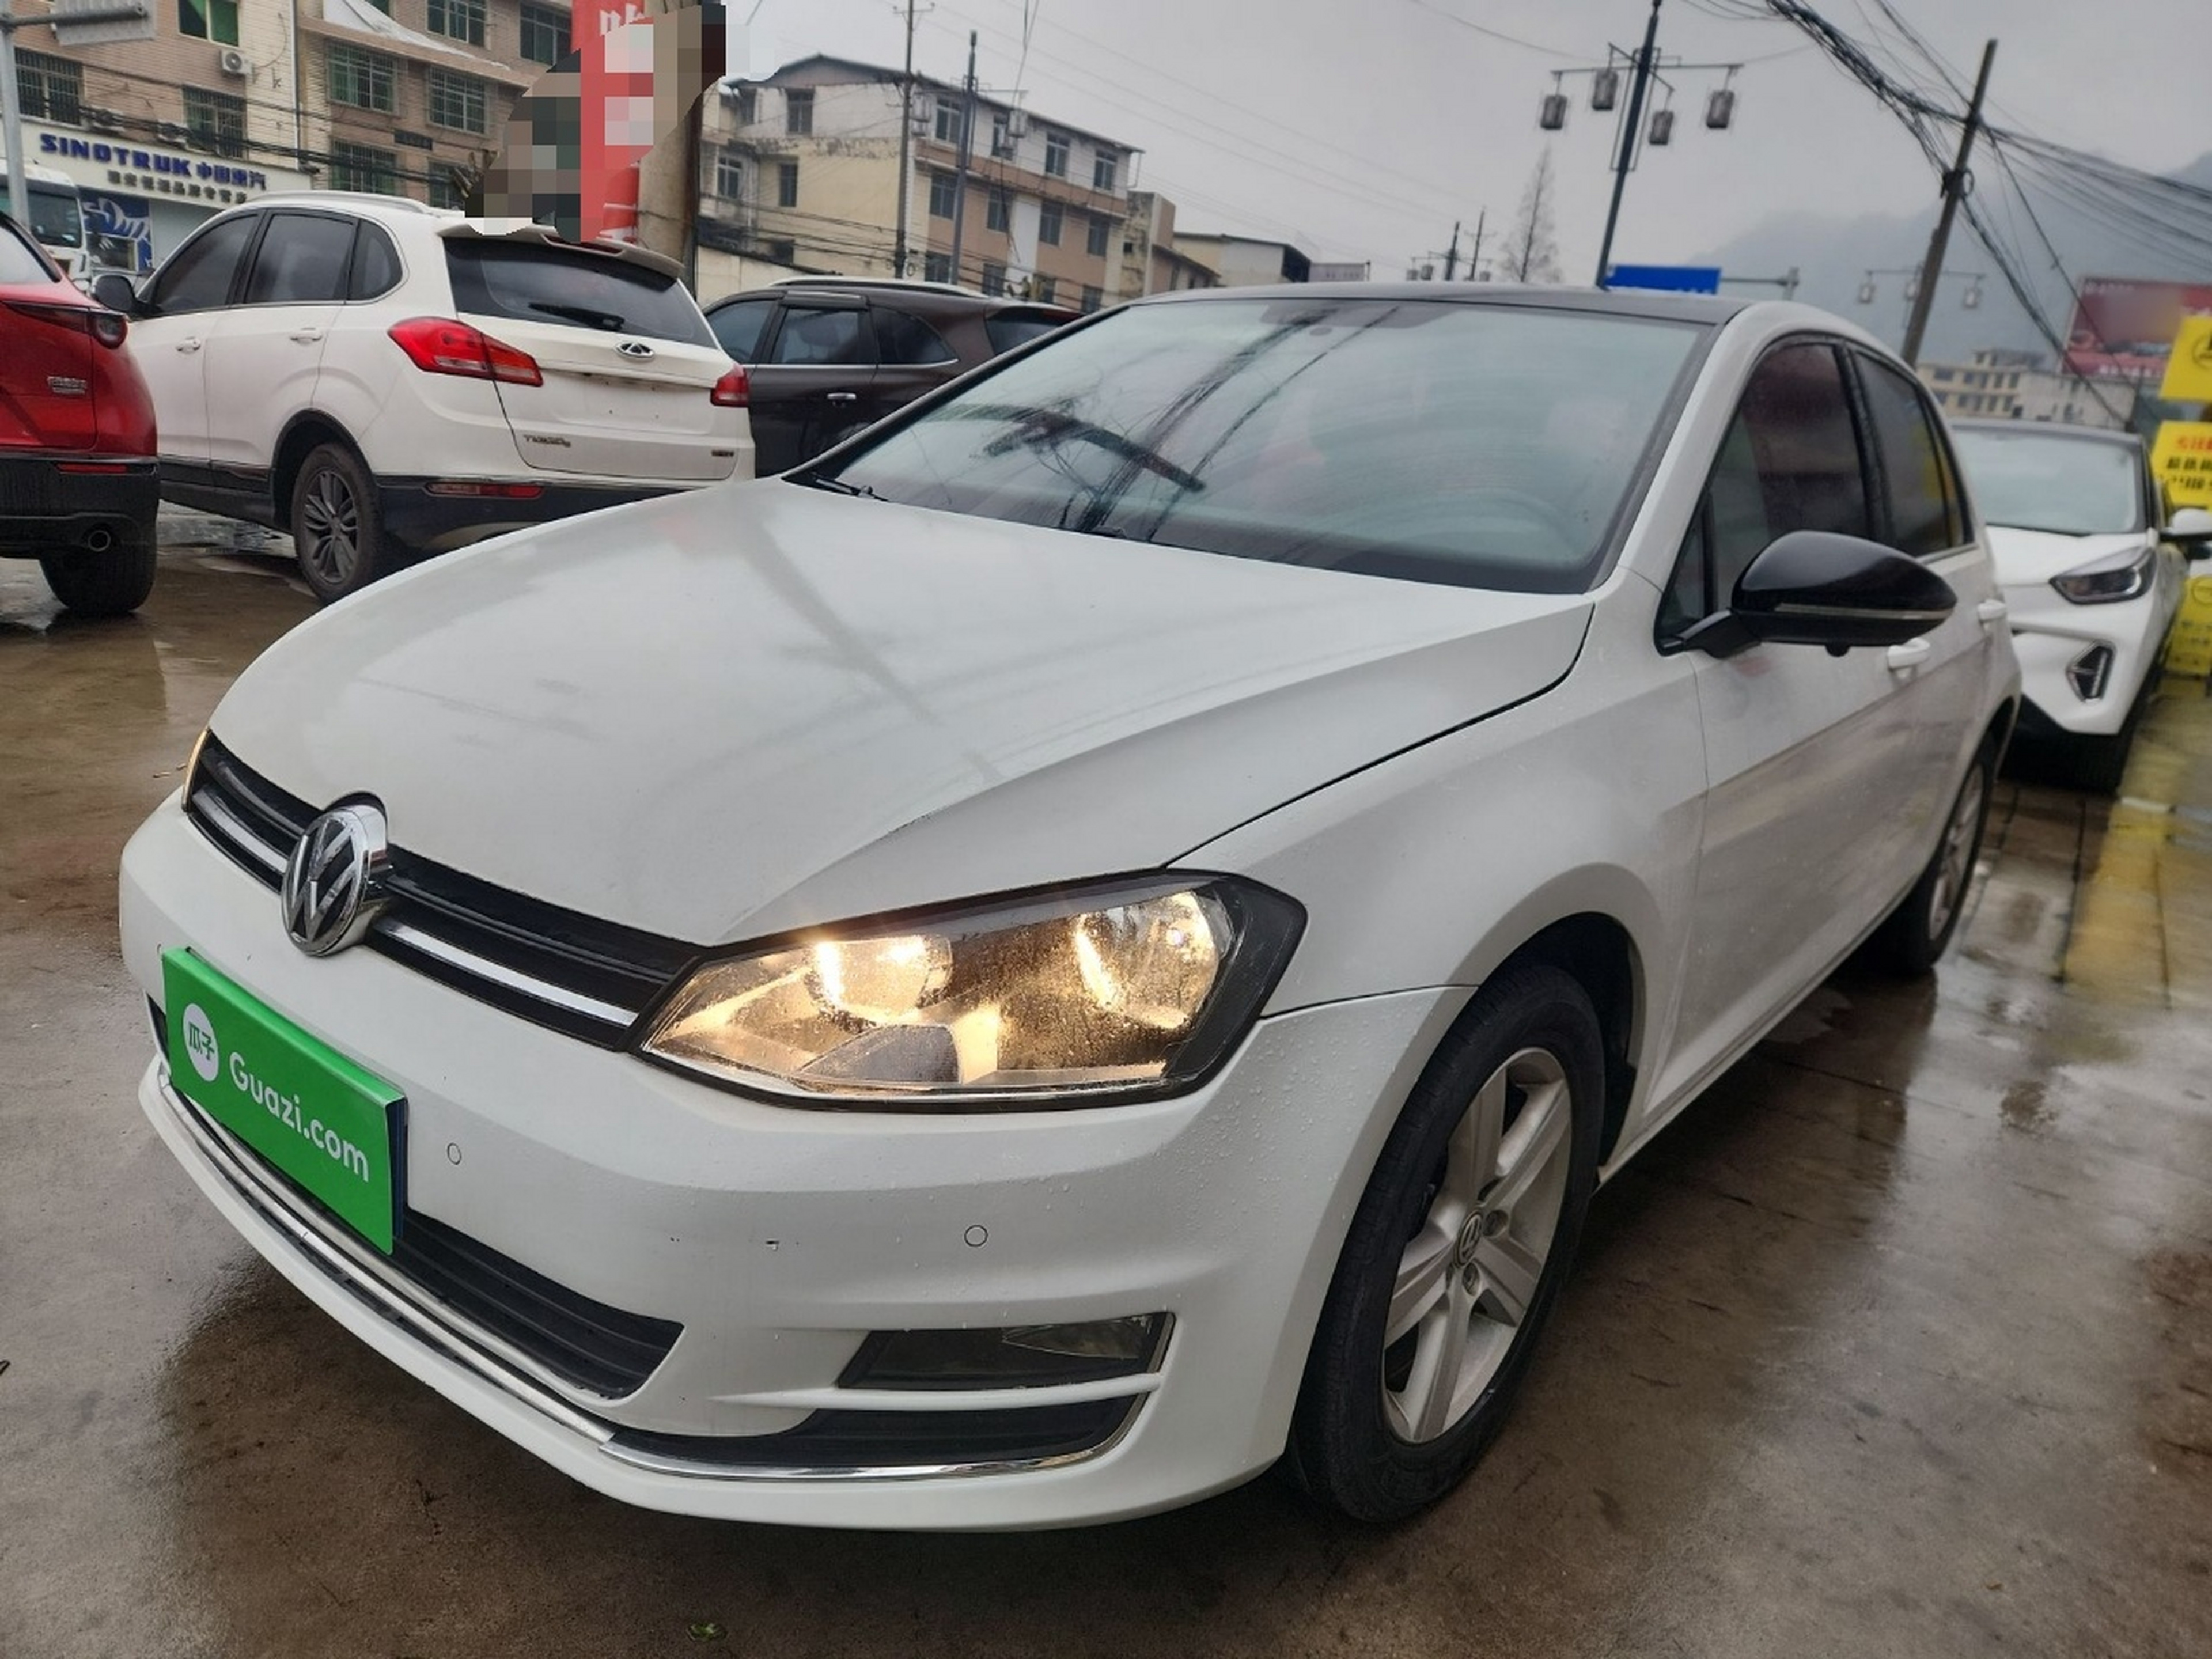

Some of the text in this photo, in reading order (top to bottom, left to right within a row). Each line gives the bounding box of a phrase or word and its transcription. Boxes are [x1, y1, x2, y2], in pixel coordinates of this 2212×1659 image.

[40, 134, 191, 177] SINOTRUK
[188, 1021, 215, 1061] 瓜子
[230, 1052, 369, 1183] Guazi.com
